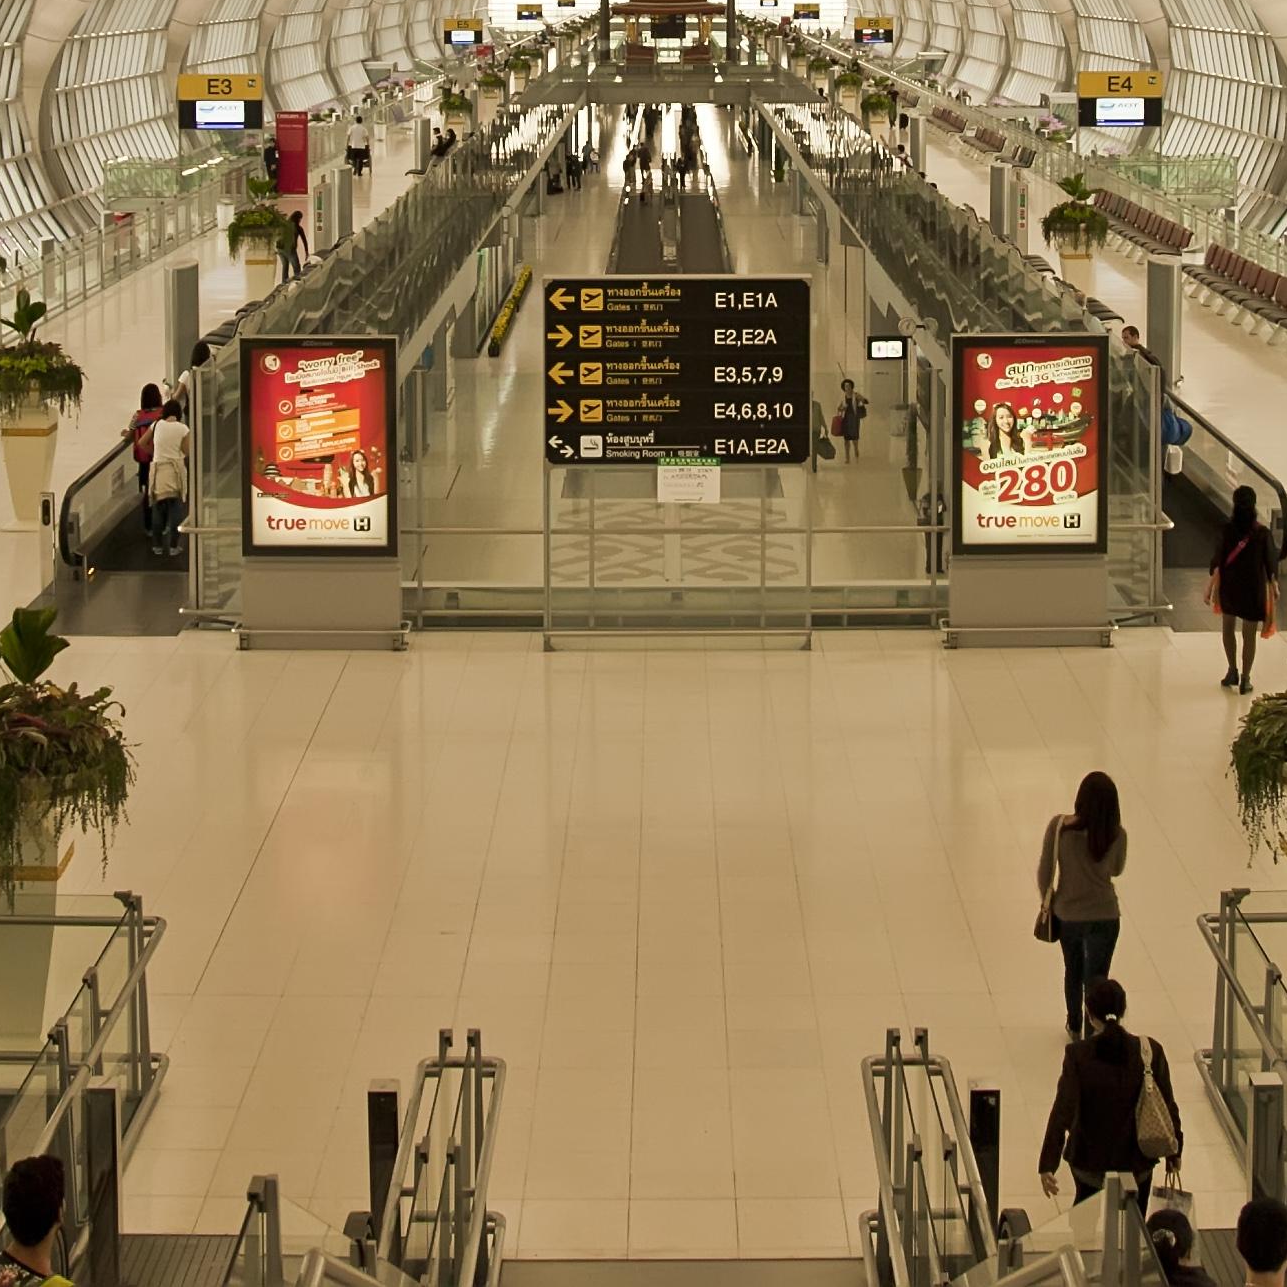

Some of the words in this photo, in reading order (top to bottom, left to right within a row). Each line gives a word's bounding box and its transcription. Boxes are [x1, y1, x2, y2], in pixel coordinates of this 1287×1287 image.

[457, 21, 470, 29] E5
[207, 79, 232, 95] E3
[1108, 76, 1133, 92] E4
[607, 282, 681, 297] ทางออกขึ้นเครื่อง
[607, 303, 631, 311] Gates
[715, 292, 778, 310] E1,E1A
[605, 319, 680, 334] ทางออกขึ้นเครื่อง
[606, 340, 630, 348] Gates
[714, 329, 777, 347] E2,E2A
[606, 377, 630, 385] Gates
[714, 366, 783, 385] E3,5,7,9
[606, 414, 630, 422] Gates
[714, 402, 793, 421] E4,6,8,10
[606, 450, 641, 459] Smoking
[642, 450, 666, 458] Room
[714, 439, 790, 457] E1A,E2A
[998, 460, 1073, 502] 280
[266, 515, 307, 530] true
[309, 519, 350, 530] move
[977, 513, 1017, 528] true
[1019, 516, 1060, 528] move
